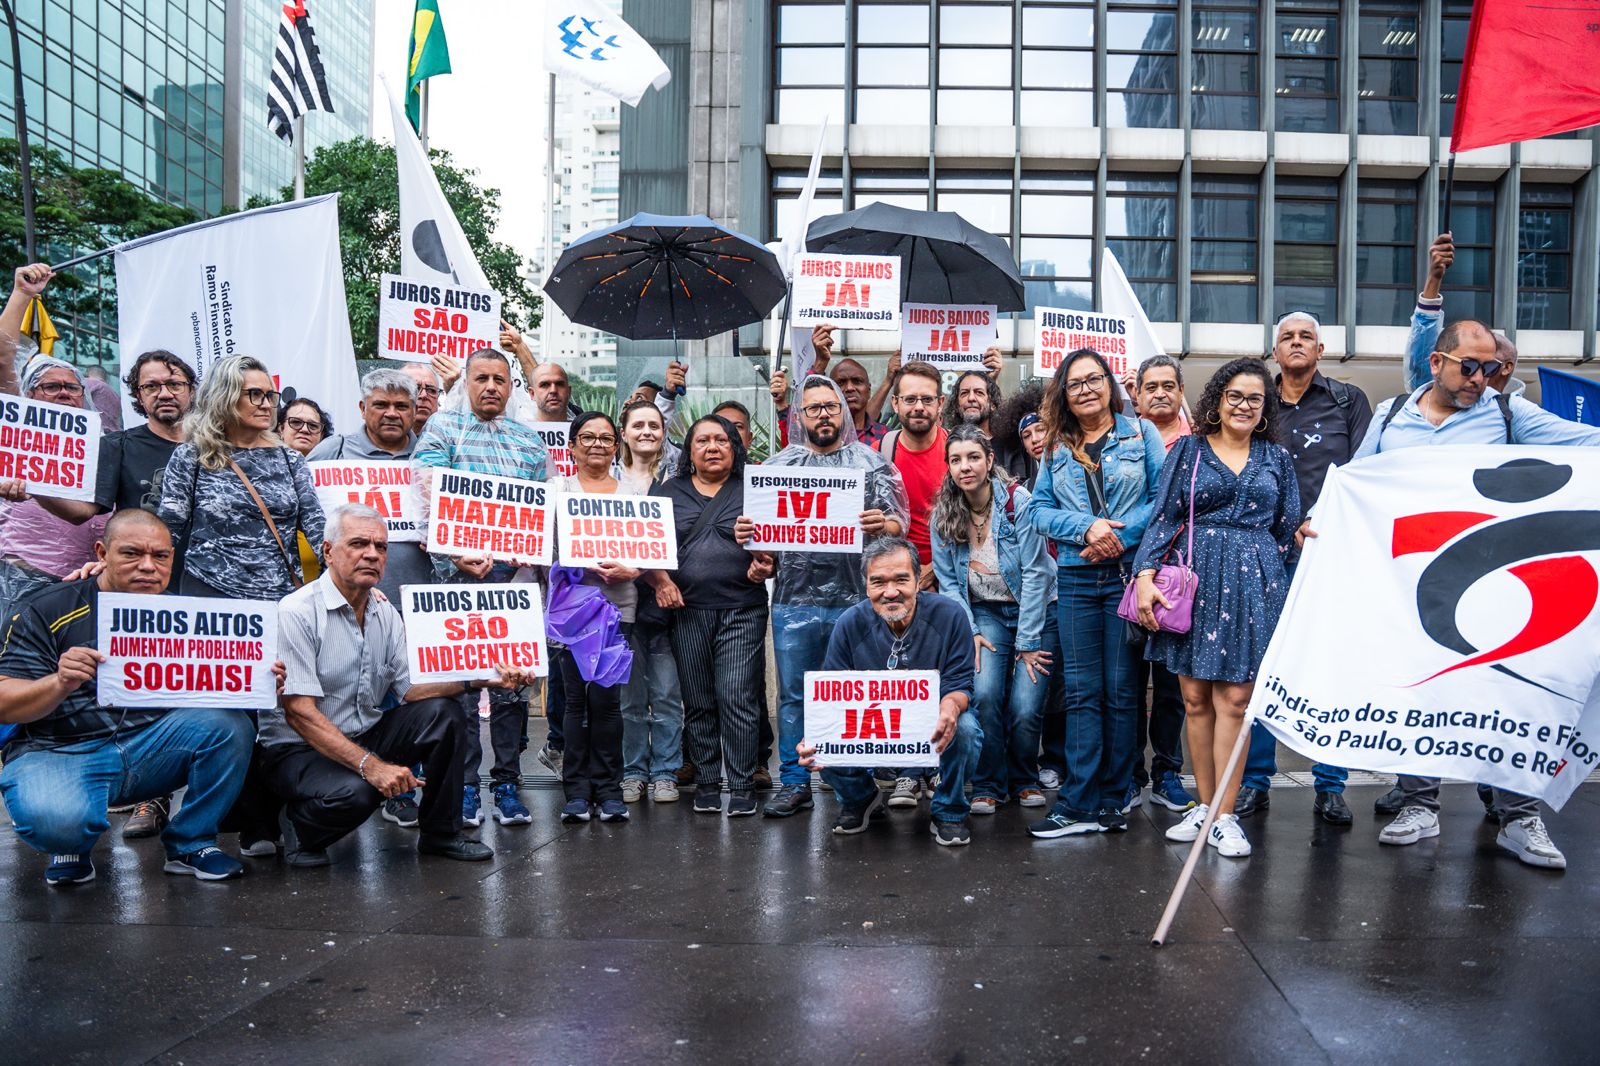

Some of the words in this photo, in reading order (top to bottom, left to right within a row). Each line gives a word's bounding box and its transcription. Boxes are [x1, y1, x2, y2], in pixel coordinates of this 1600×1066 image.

[800, 259, 841, 277] JUROS
[845, 260, 893, 280] BAIXOS
[205, 265, 217, 301] Ramo
[822, 279, 870, 308] JÁ!
[220, 281, 233, 337] Sindicato
[389, 281, 441, 306] JUROS
[443, 289, 492, 313] ALTOS
[414, 307, 468, 334] SÃO
[799, 307, 893, 321] #JurosBaixosJá
[908, 308, 945, 325] JUROS
[948, 309, 990, 326] BAIXOS
[1042, 312, 1084, 331] JUROS
[1086, 316, 1126, 335] ALTOS
[226, 339, 236, 354] do
[927, 326, 971, 352] JÁ!
[1041, 328, 1066, 349] SÃO
[1069, 333, 1126, 355] INIMIGOS
[907, 351, 986, 363] #JurosBaixosJ
[1041, 350, 1062, 369] DO
[24, 405, 88, 435] ALTOS
[62, 436, 86, 460] AS
[314, 467, 364, 487] JUROS
[367, 467, 411, 485] BAIXO
[439, 473, 493, 501] JUROS
[497, 481, 546, 506] ALTOS
[751, 475, 858, 490] #JurosBaixosJá
[436, 496, 545, 534] MATAM
[567, 497, 634, 518] CONTRA
[638, 501, 662, 519] OS
[776, 490, 831, 524] JÁ!
[436, 522, 449, 546] O
[453, 526, 544, 557] EMPREGO!
[570, 517, 665, 539] JUROS
[752, 524, 806, 544] BAIXOS
[809, 526, 856, 545] JUROS
[570, 539, 668, 560] ABUSIVOS!
[412, 591, 472, 613] JUROS
[476, 589, 531, 611] ALTOS
[110, 607, 189, 635] JUROS
[194, 612, 264, 638] ALTOS
[444, 613, 508, 641] SÃO
[110, 636, 185, 659] AUMENTAM
[187, 638, 263, 662] PROBLEMAS
[418, 641, 540, 673] INDECENTES!
[123, 661, 252, 692] SOCIAIS!
[813, 679, 863, 702] JUROS
[868, 679, 930, 701] BAIXOS
[841, 703, 903, 740] JÁ!
[1355, 702, 1398, 724] dos
[1404, 709, 1530, 739] Bancarios
[1537, 728, 1551, 743] e
[814, 741, 931, 756] #JurosBaixosJá
[1293, 720, 1331, 747] São
[1336, 730, 1408, 756] Paulo,
[1414, 736, 1504, 764] Osasco
[1511, 753, 1526, 769] e
